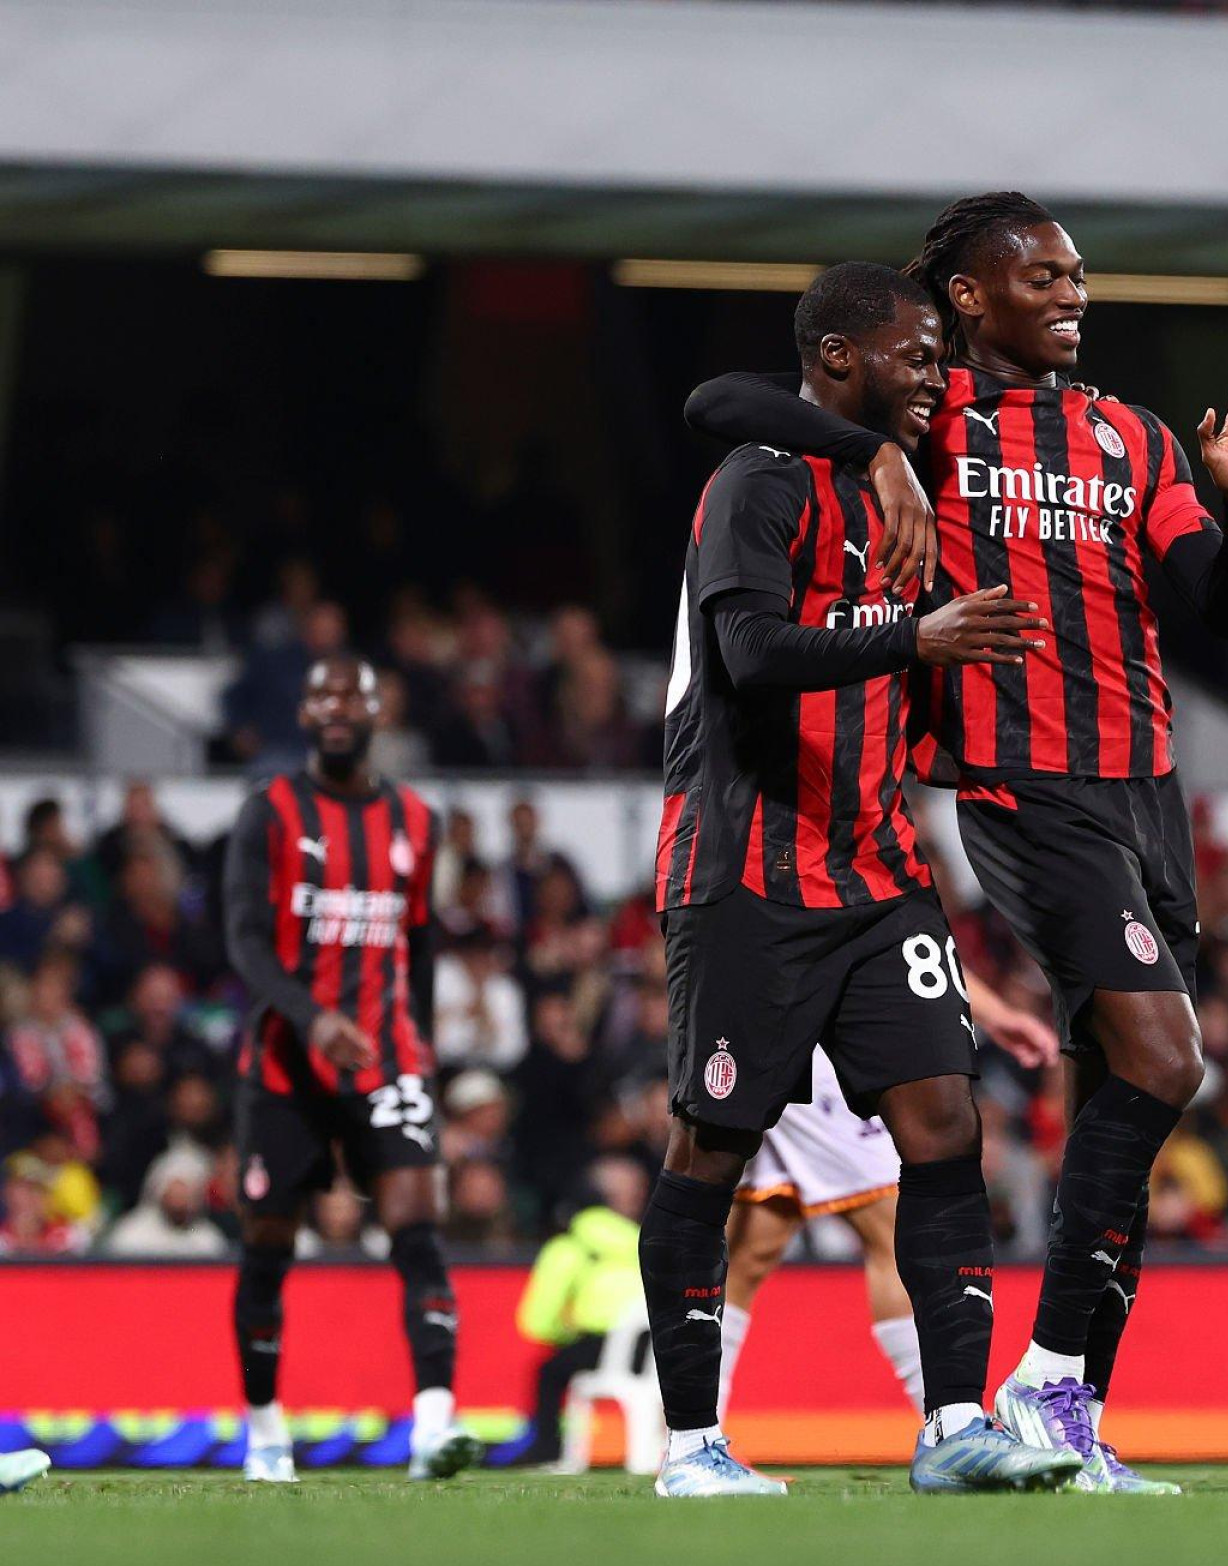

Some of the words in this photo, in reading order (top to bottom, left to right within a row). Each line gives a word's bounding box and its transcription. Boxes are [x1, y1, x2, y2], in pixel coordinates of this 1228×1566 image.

[955, 455, 1137, 518] Emirates
[989, 505, 1030, 540] FLY
[1038, 507, 1114, 545] BETTER
